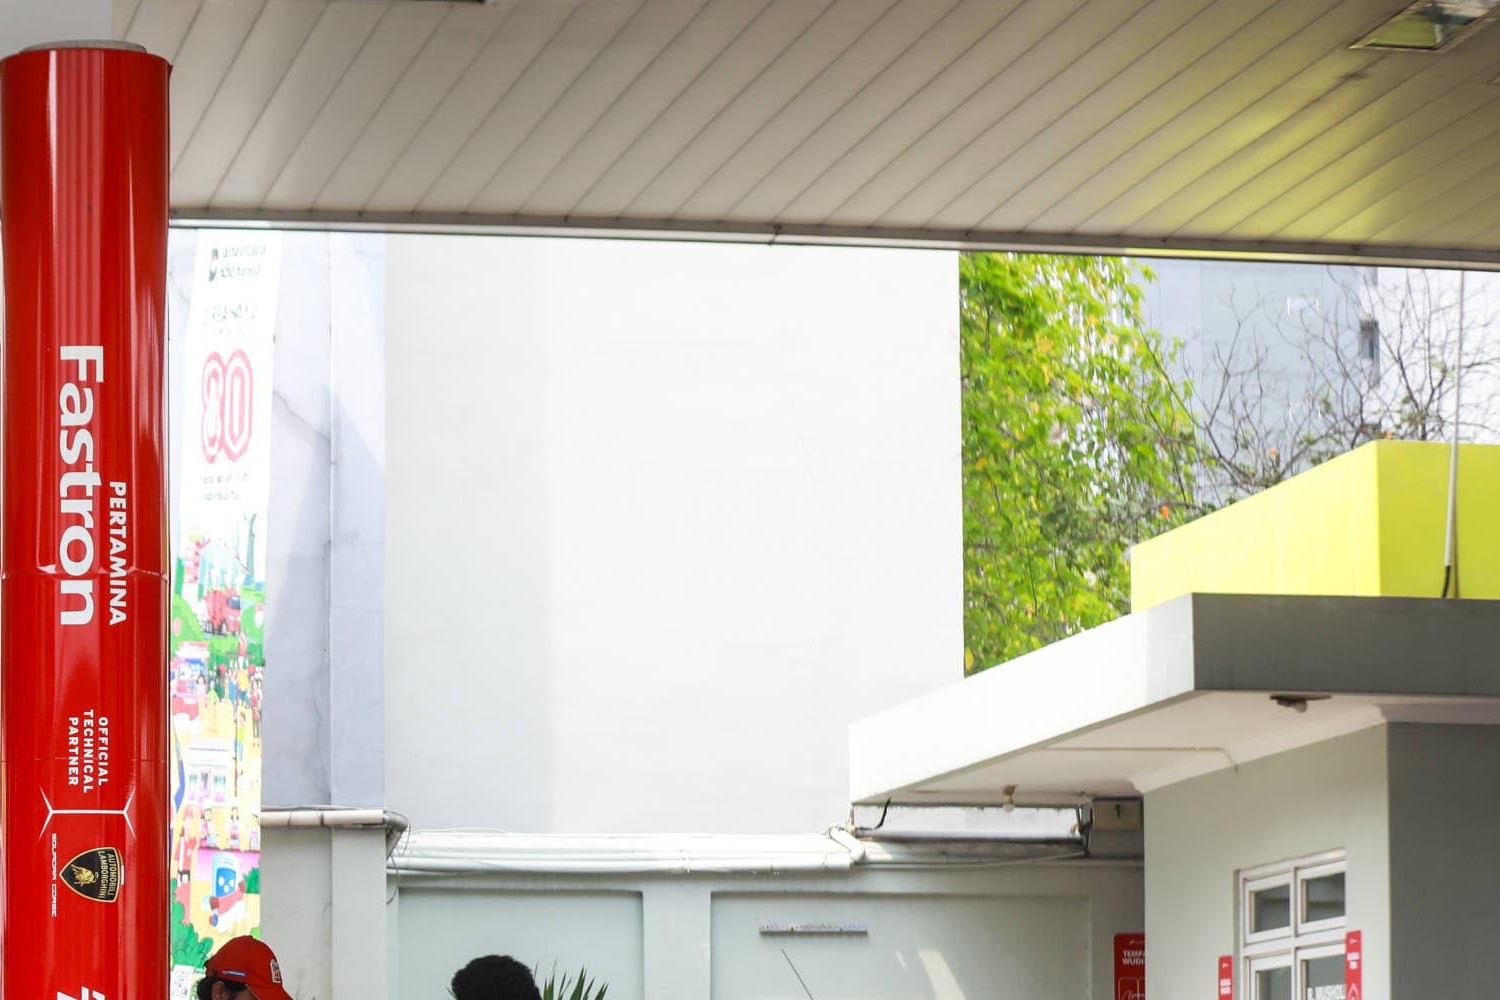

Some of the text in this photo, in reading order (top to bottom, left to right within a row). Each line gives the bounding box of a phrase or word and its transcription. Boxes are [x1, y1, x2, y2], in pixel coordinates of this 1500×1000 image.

[59, 344, 104, 626] Fastron
[108, 480, 127, 626] PERTAMINA
[68, 716, 79, 786] PARTNER
[83, 708, 94, 794] TECHNICAL
[97, 716, 109, 787] OFFICIAL
[98, 850, 109, 899] LAMBORGHINI
[107, 853, 117, 897] AUTOMOBILI
[1122, 950, 1145, 958] TEMP
